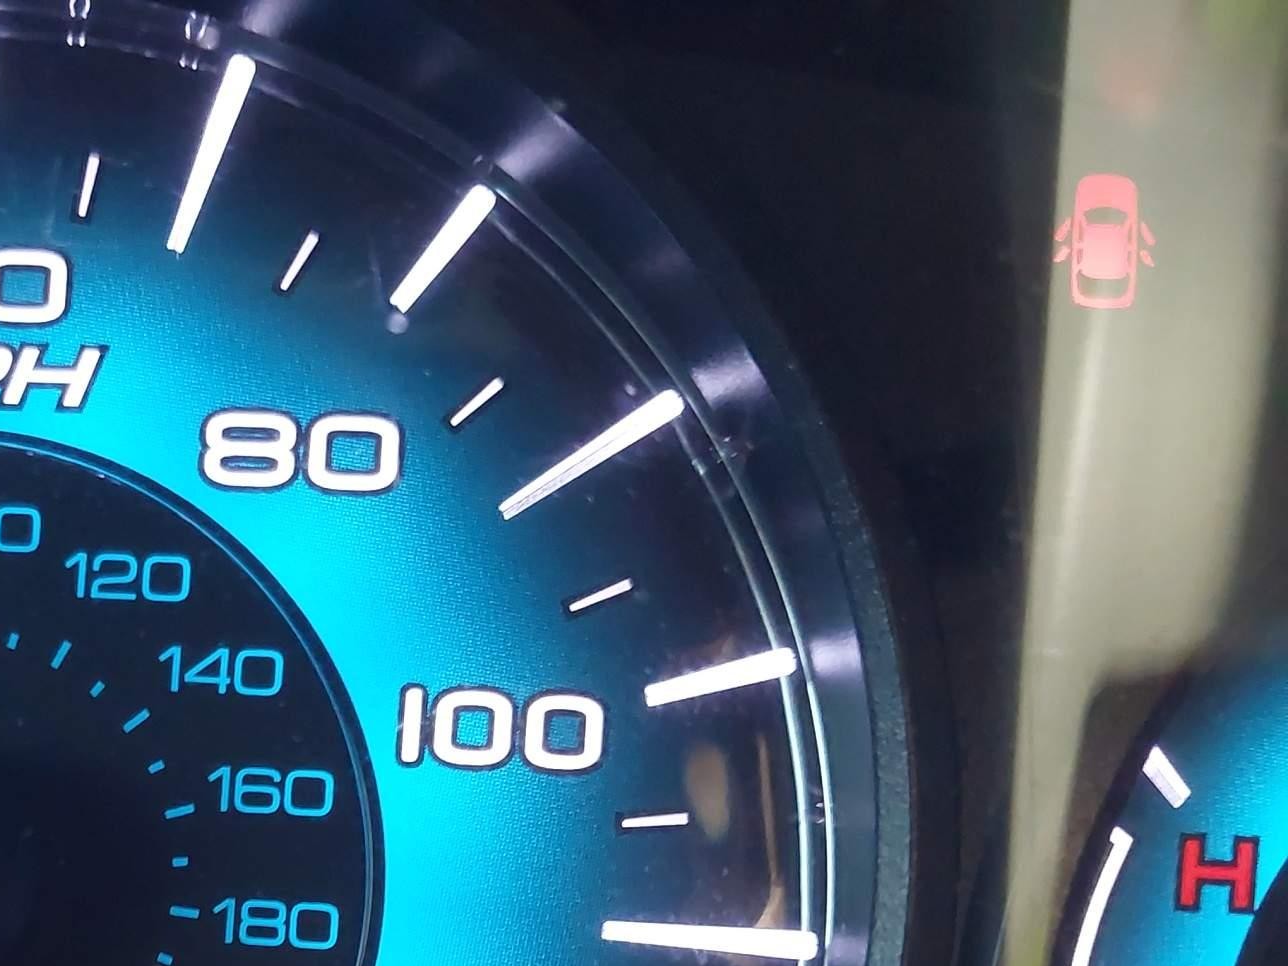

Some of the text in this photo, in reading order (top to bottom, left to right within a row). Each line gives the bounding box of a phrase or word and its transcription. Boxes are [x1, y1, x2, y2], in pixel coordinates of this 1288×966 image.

[203, 410, 401, 491] 80
[66, 553, 191, 601] 120
[159, 645, 283, 696] 140
[401, 685, 604, 771] 100
[208, 766, 334, 817] 160
[1177, 836, 1257, 911] H
[213, 898, 338, 948] 180
